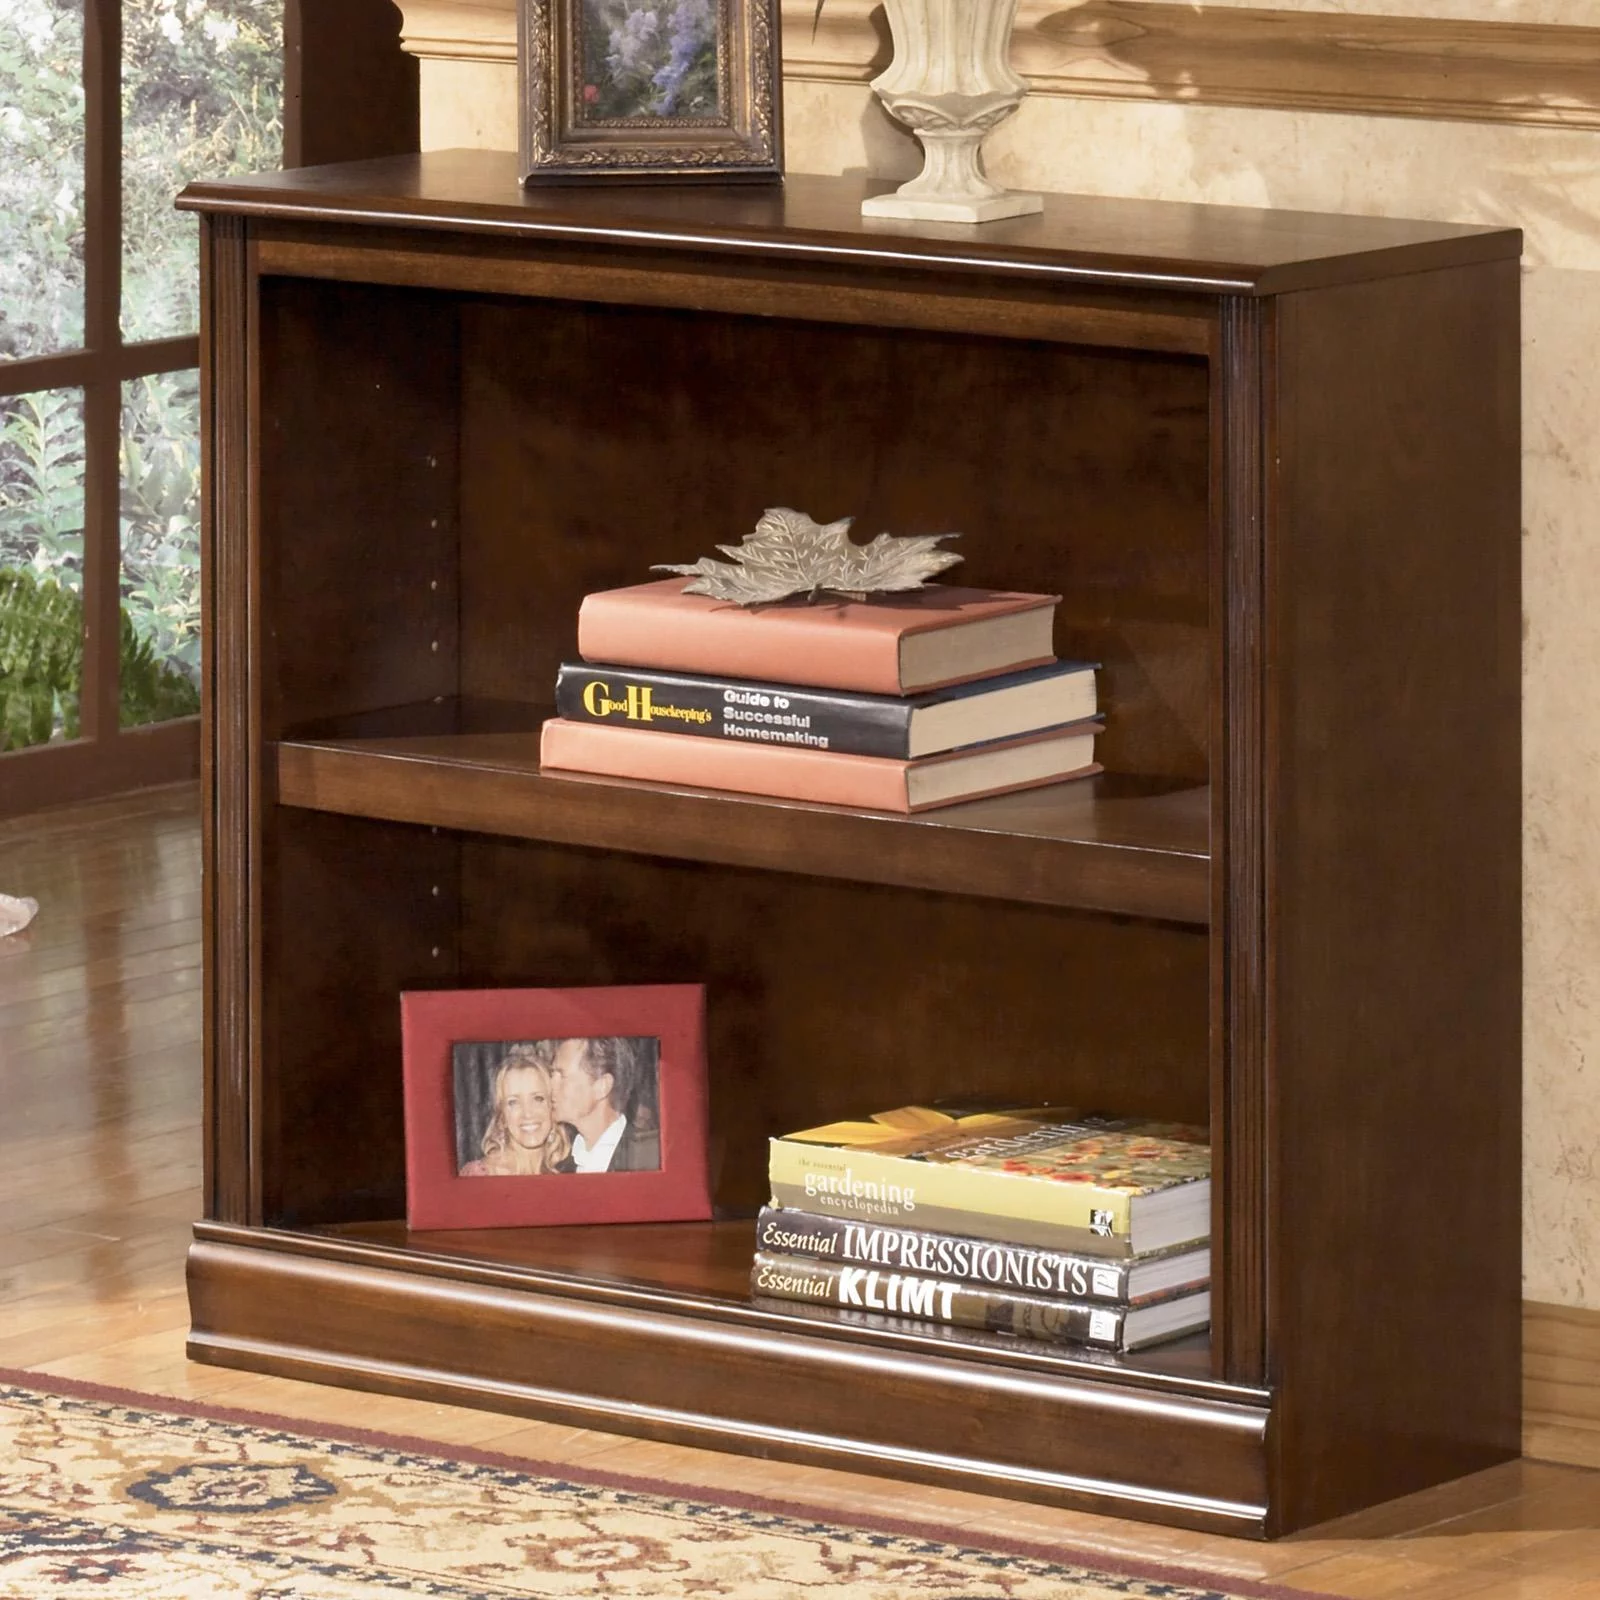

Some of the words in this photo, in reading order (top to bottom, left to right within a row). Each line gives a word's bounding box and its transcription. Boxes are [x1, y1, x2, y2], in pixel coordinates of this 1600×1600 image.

[583, 681, 628, 717] Good
[625, 685, 712, 723] Housekeeping's
[723, 690, 770, 707] Guide
[773, 696, 790, 709] to
[723, 706, 811, 728] Successful
[723, 723, 829, 748] Homemaking
[804, 1168, 916, 1211] gardening
[820, 1195, 900, 1216] encyclopedia
[763, 1222, 839, 1254] Essential
[842, 1225, 1088, 1296] IMPRESSIONISTS
[757, 1265, 833, 1297] Essential
[838, 1266, 962, 1319] KLIMT
